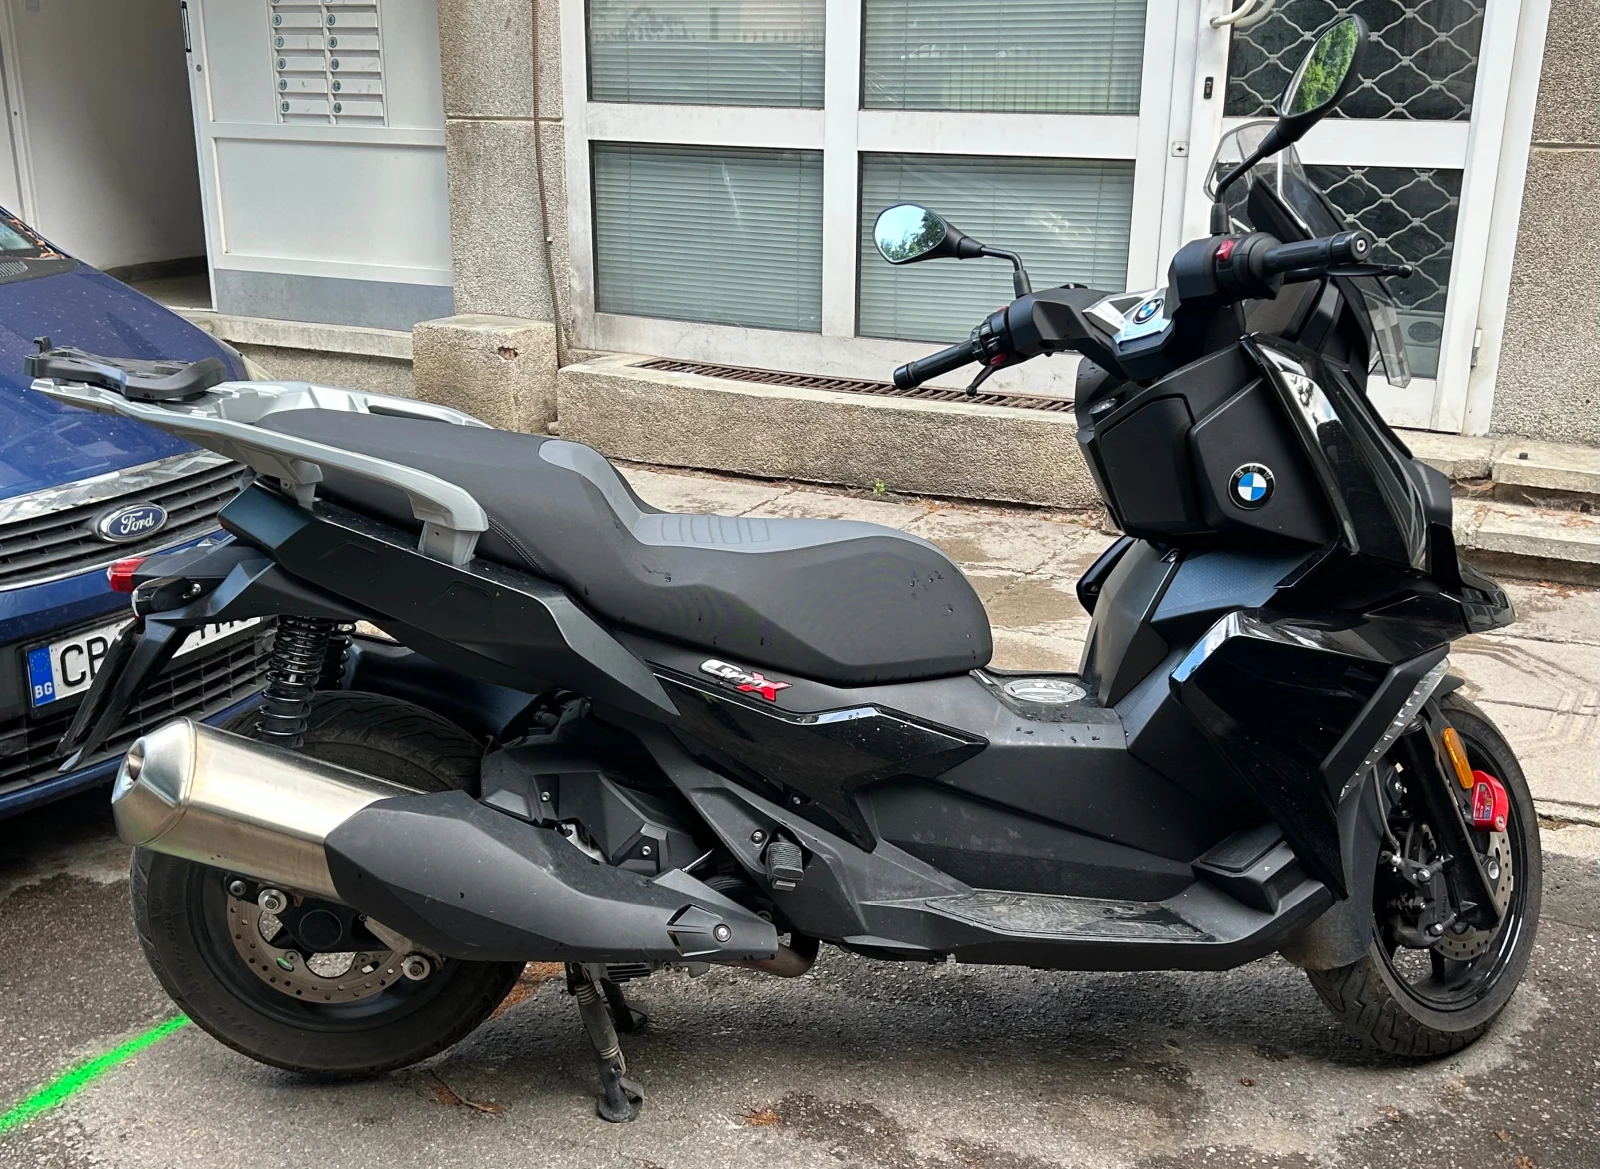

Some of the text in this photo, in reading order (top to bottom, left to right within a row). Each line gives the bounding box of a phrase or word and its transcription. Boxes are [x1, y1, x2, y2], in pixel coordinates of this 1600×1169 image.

[1235, 465, 1272, 480] BMW
[120, 511, 155, 534] Ford
[34, 682, 53, 698] BG
